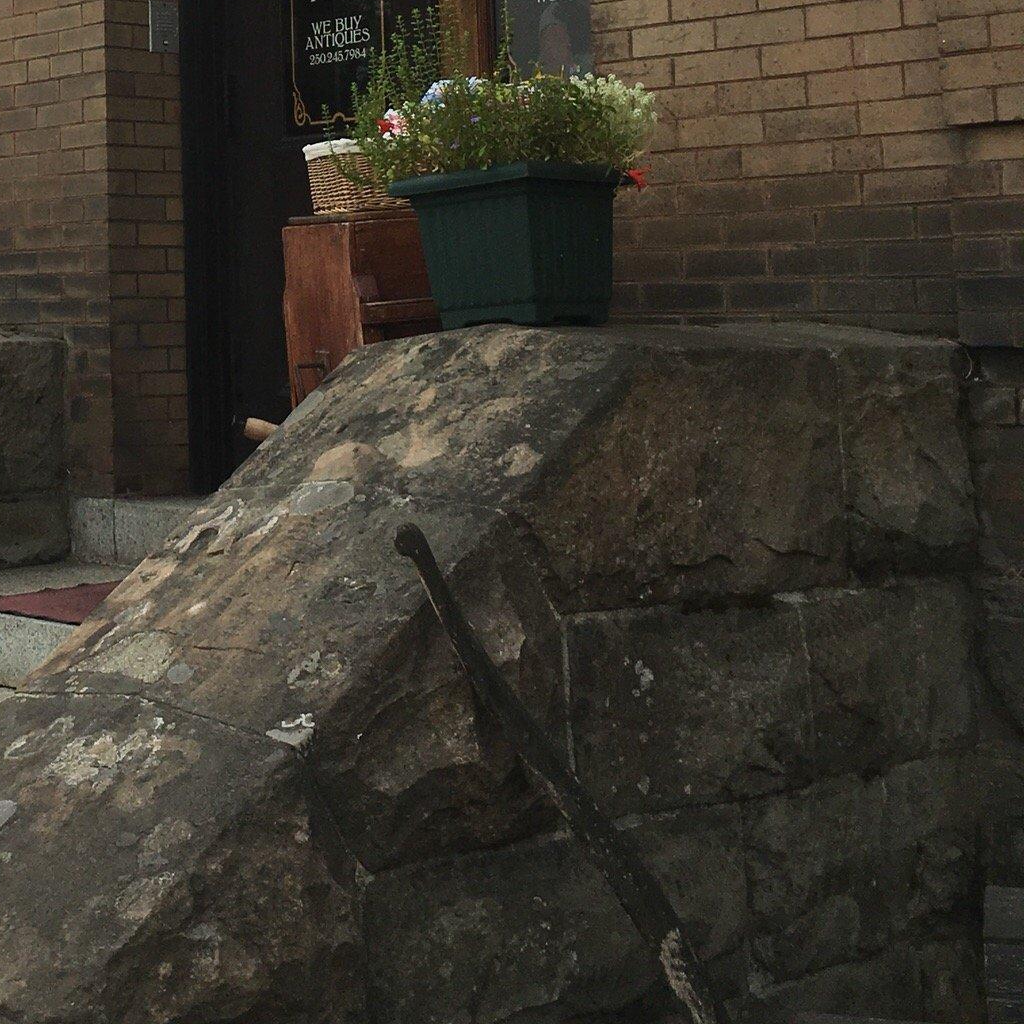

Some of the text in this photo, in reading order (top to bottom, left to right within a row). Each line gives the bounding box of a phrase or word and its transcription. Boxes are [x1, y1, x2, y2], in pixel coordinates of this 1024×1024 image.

[311, 15, 363, 36] WE BUY
[305, 27, 371, 51] ANTIQUES
